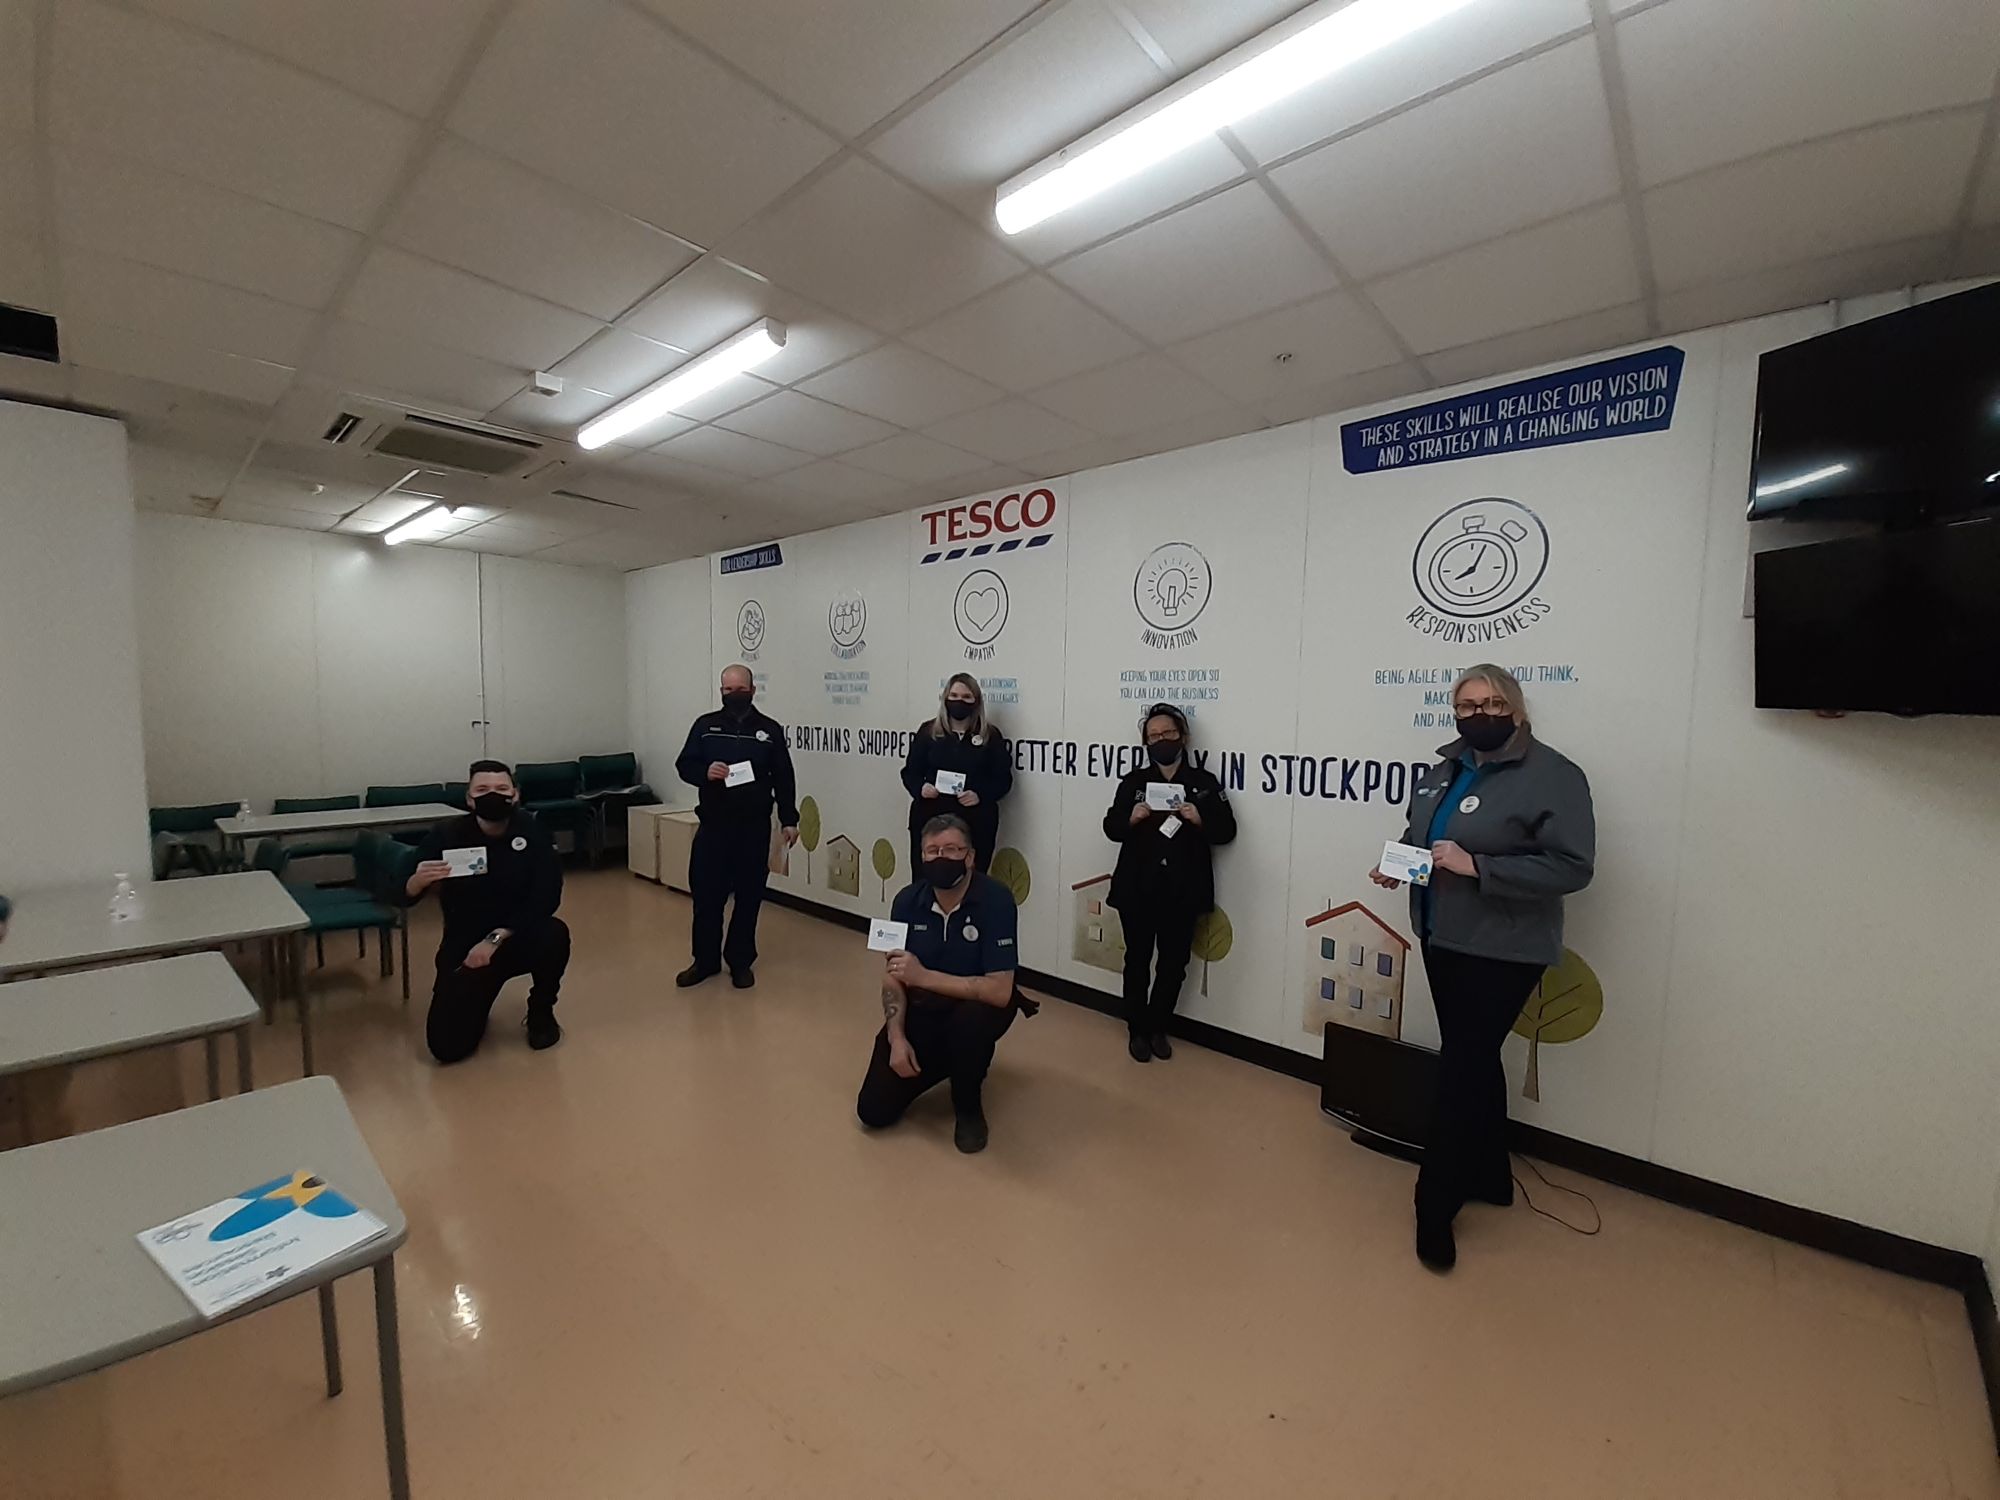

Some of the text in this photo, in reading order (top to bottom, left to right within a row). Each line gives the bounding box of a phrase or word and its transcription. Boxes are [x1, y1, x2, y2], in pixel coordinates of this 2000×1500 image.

[1360, 365, 1668, 448] THESE SKILLS WILL REALISE OUR VISION
[1378, 395, 1667, 467] AND STRATEGY IN A CHANGING WORLD
[921, 489, 1056, 545] TESCO
[1406, 597, 1551, 643] RESPONSIVENESS
[1141, 627, 1198, 649] INNOVATION
[964, 644, 996, 660] EMPATHY
[1149, 670, 1166, 681] YOUR
[1168, 669, 1186, 681] EYES
[1188, 669, 1206, 681] OPEN
[1209, 669, 1219, 681] SO
[1375, 669, 1404, 684] BEING
[1408, 668, 1437, 683] AGILE
[1441, 668, 1452, 683] IN
[1510, 666, 1534, 682] YOU
[1538, 665, 1579, 682] THINK,
[1120, 687, 1219, 700] YOU CAN LEAD THE BUSINESS
[1413, 712, 1434, 727] AND
[797, 726, 850, 753] BRITAINS
[1221, 751, 1246, 791] IN
